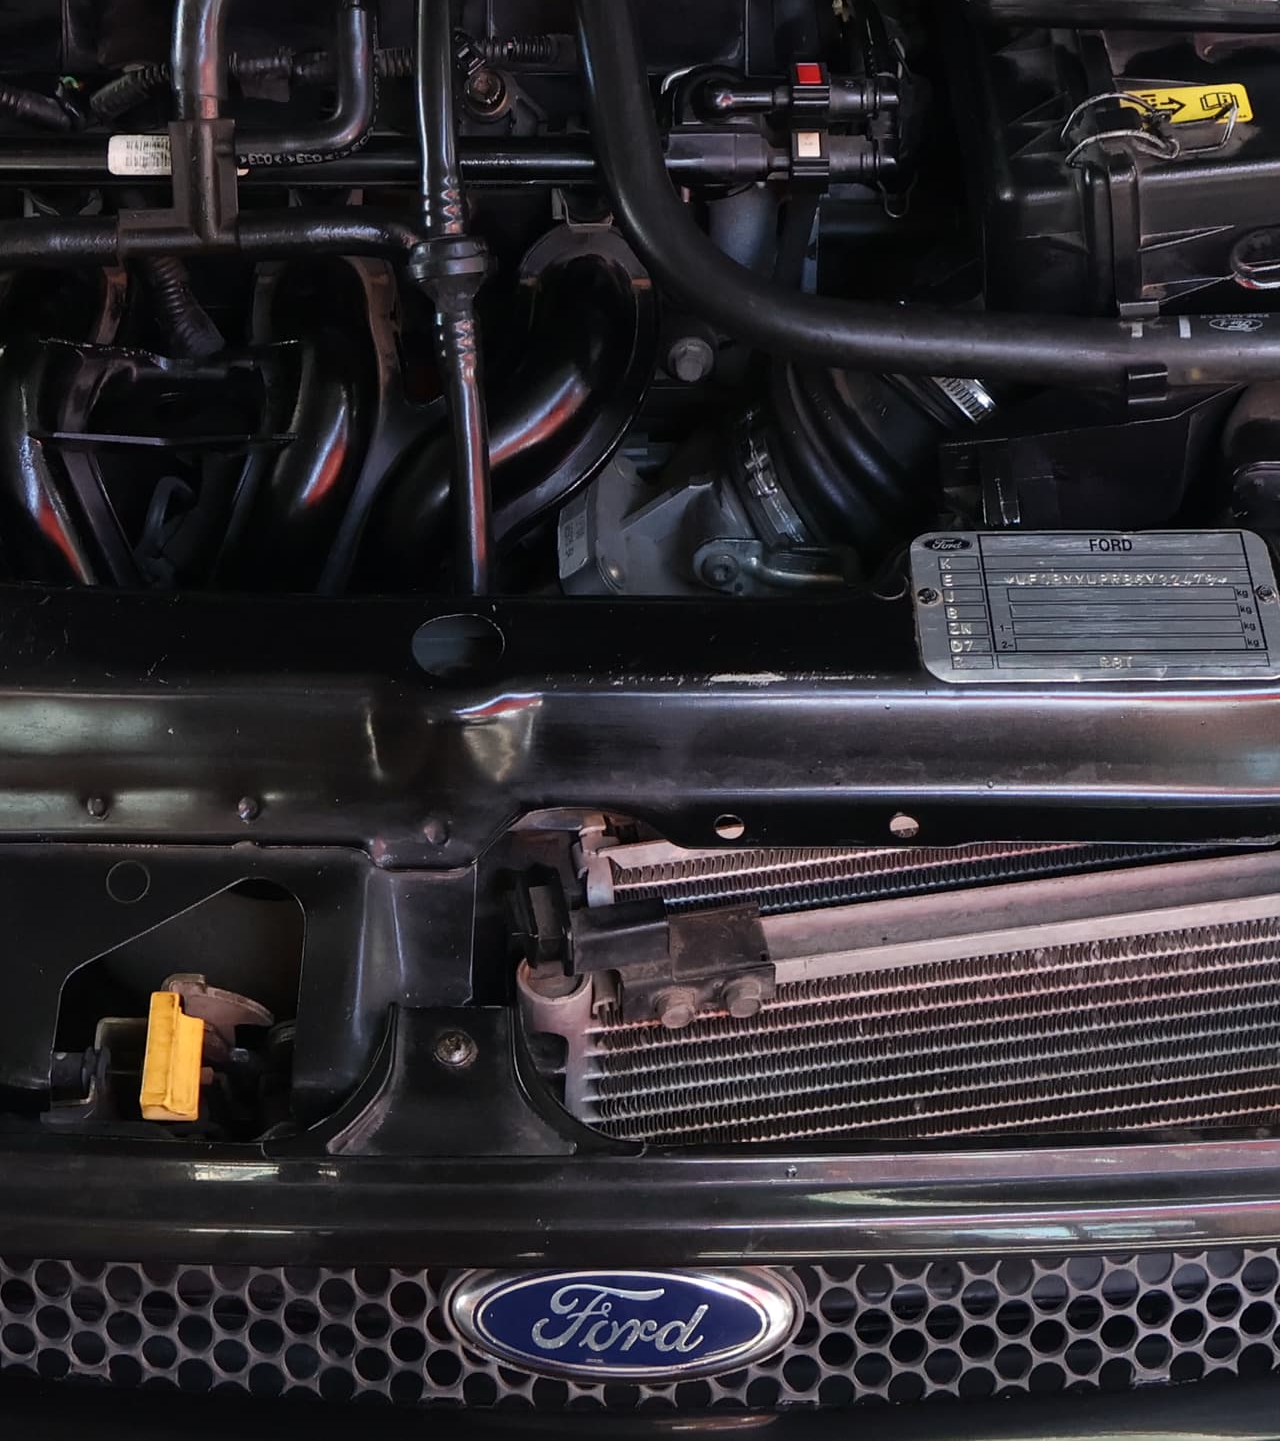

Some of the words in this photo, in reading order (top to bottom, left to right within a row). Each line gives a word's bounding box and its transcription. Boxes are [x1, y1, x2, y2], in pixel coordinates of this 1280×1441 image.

[932, 539, 962, 550] Ford
[1089, 539, 1132, 552] FORD
[944, 575, 953, 586] E
[1237, 588, 1248, 596] kg
[1240, 605, 1252, 614] kg
[1244, 622, 1256, 630] kg
[1248, 638, 1259, 647] kg
[531, 1283, 709, 1353] Ford
